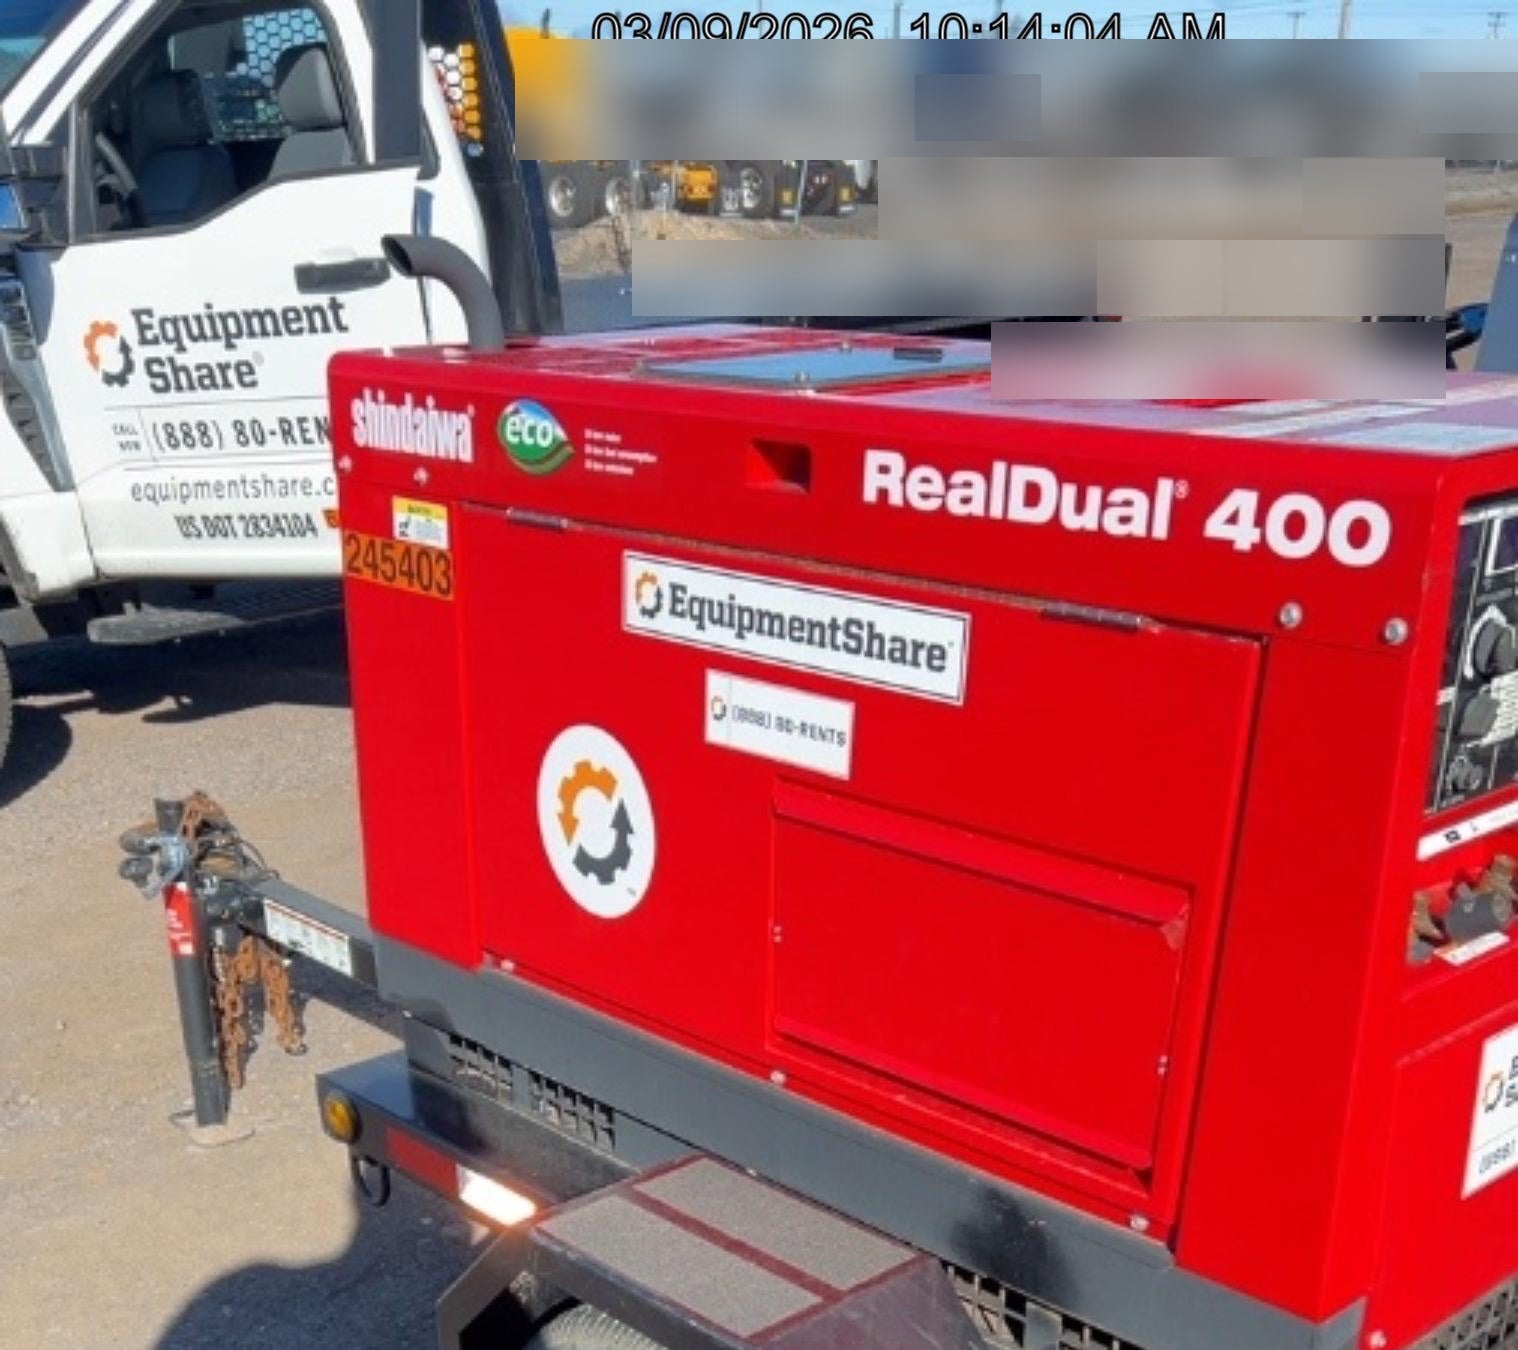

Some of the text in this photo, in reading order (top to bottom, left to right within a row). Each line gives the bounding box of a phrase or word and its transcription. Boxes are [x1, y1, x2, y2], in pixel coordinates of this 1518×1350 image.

[131, 297, 349, 353] Equipment
[153, 415, 333, 453] (888) 80-REN
[351, 387, 474, 463] shindaiwa
[506, 413, 552, 447] eco
[131, 473, 335, 506] equipmentshare.c
[174, 514, 202, 539] US
[201, 513, 238, 539] DOT
[1204, 488, 1392, 567] 400
[346, 533, 451, 597] 245403
[667, 581, 949, 673] EquipmentShare
